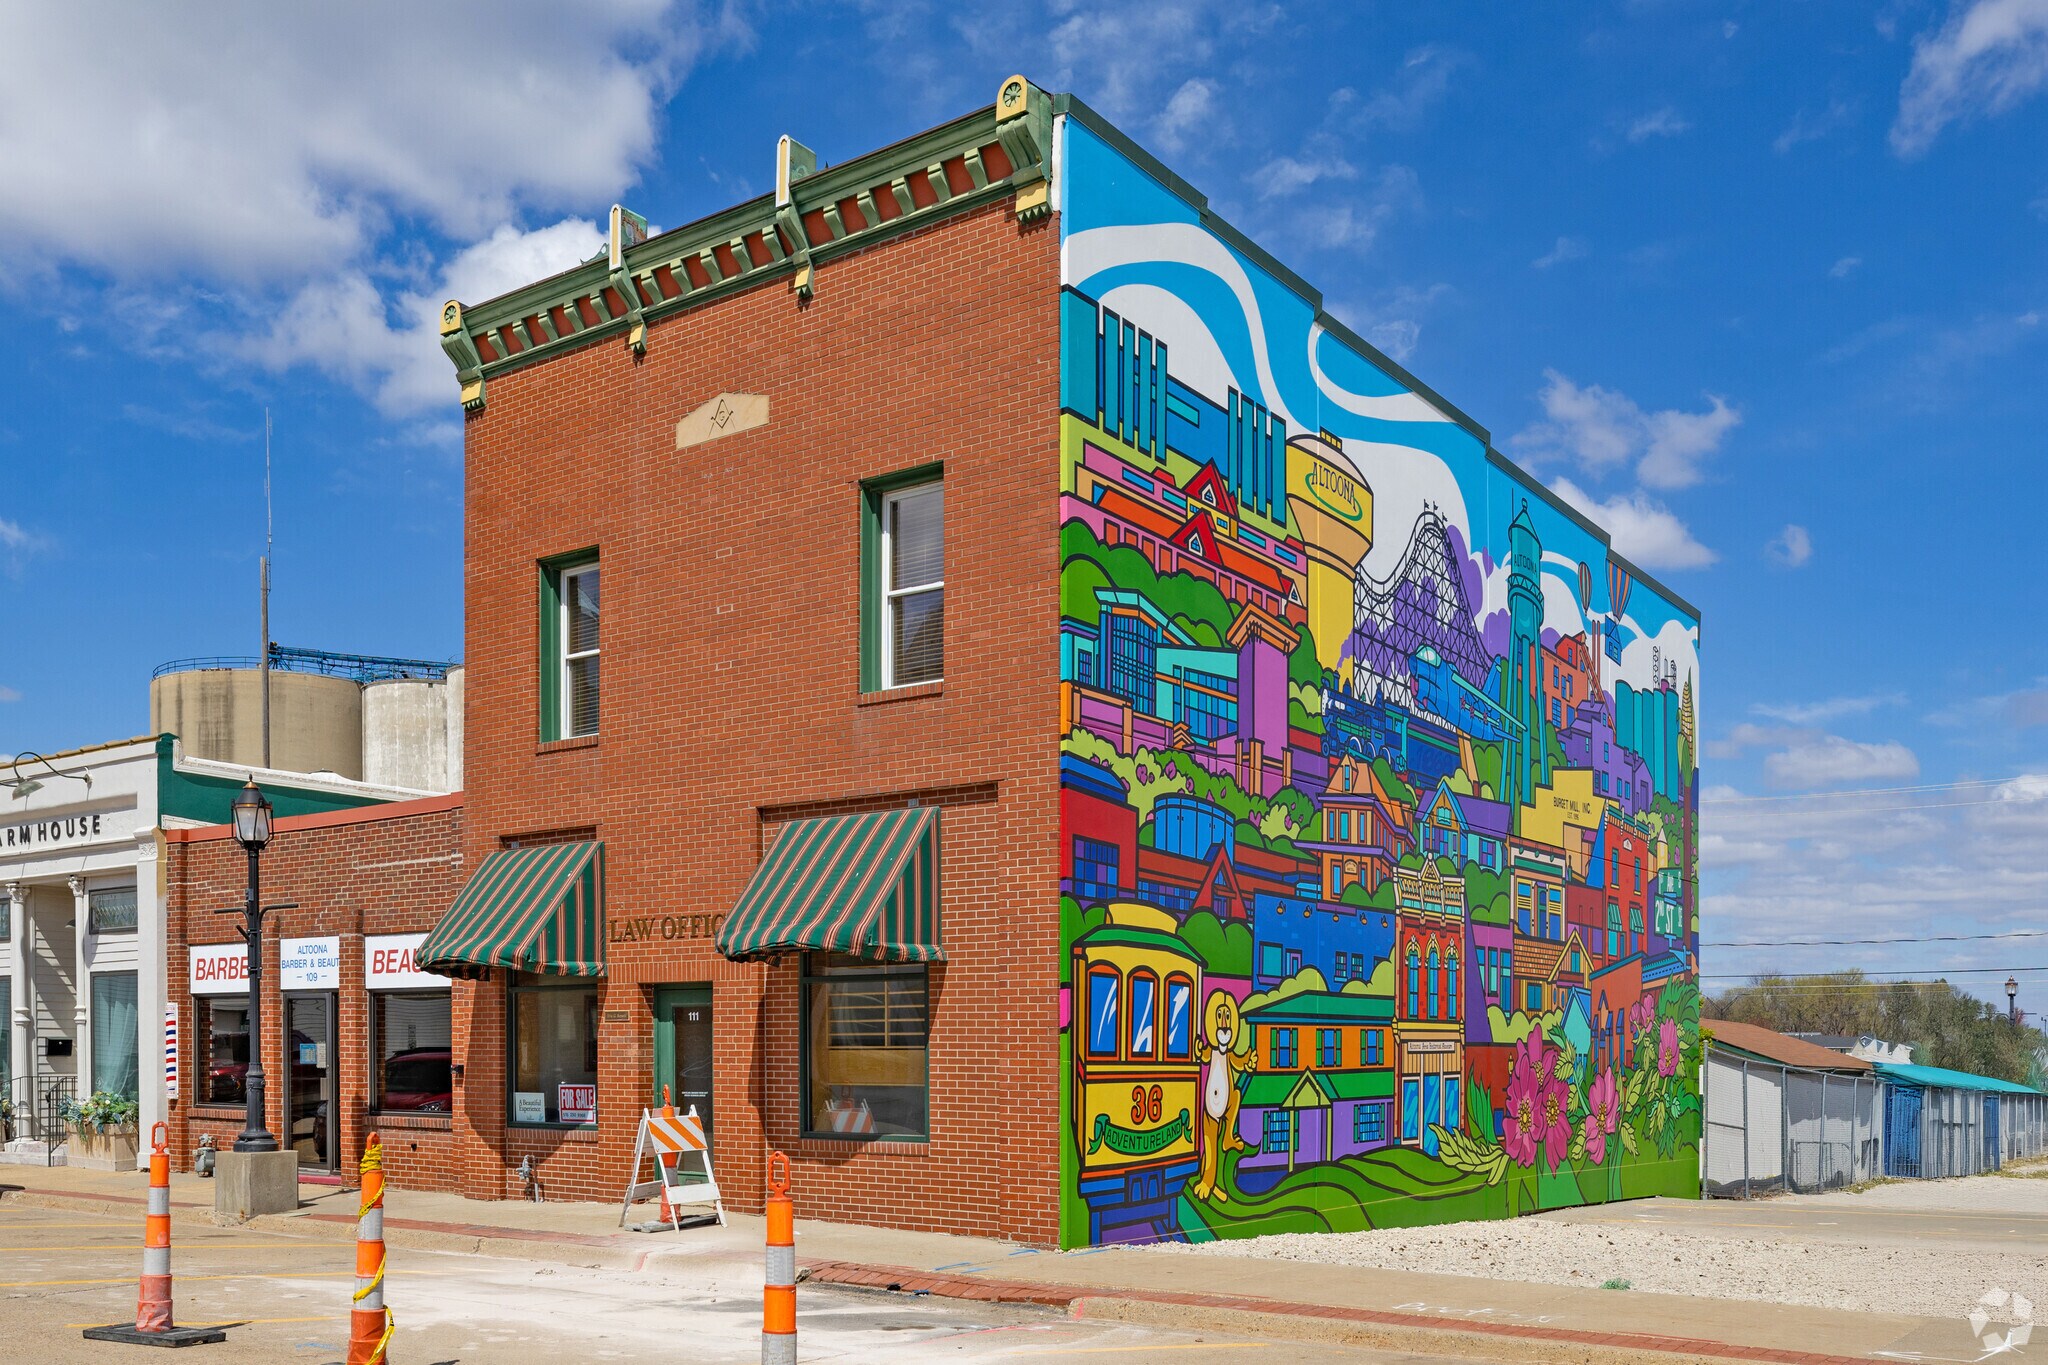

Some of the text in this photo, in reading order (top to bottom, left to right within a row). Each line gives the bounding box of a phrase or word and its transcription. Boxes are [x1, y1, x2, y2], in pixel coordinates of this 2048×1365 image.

[1311, 461, 1357, 513] ALTOONA
[1553, 796, 1569, 810] BURGET
[609, 917, 656, 942] LAW
[297, 944, 328, 955] ALTOONA
[281, 958, 308, 969] BARBER
[309, 958, 315, 968] &
[305, 972, 318, 982] 109
[688, 1011, 699, 1021] 111
[560, 1088, 593, 1109] FOR SALE
[1130, 1084, 1163, 1126] 36
[1105, 1121, 1181, 1151] ADVENTURELAND
